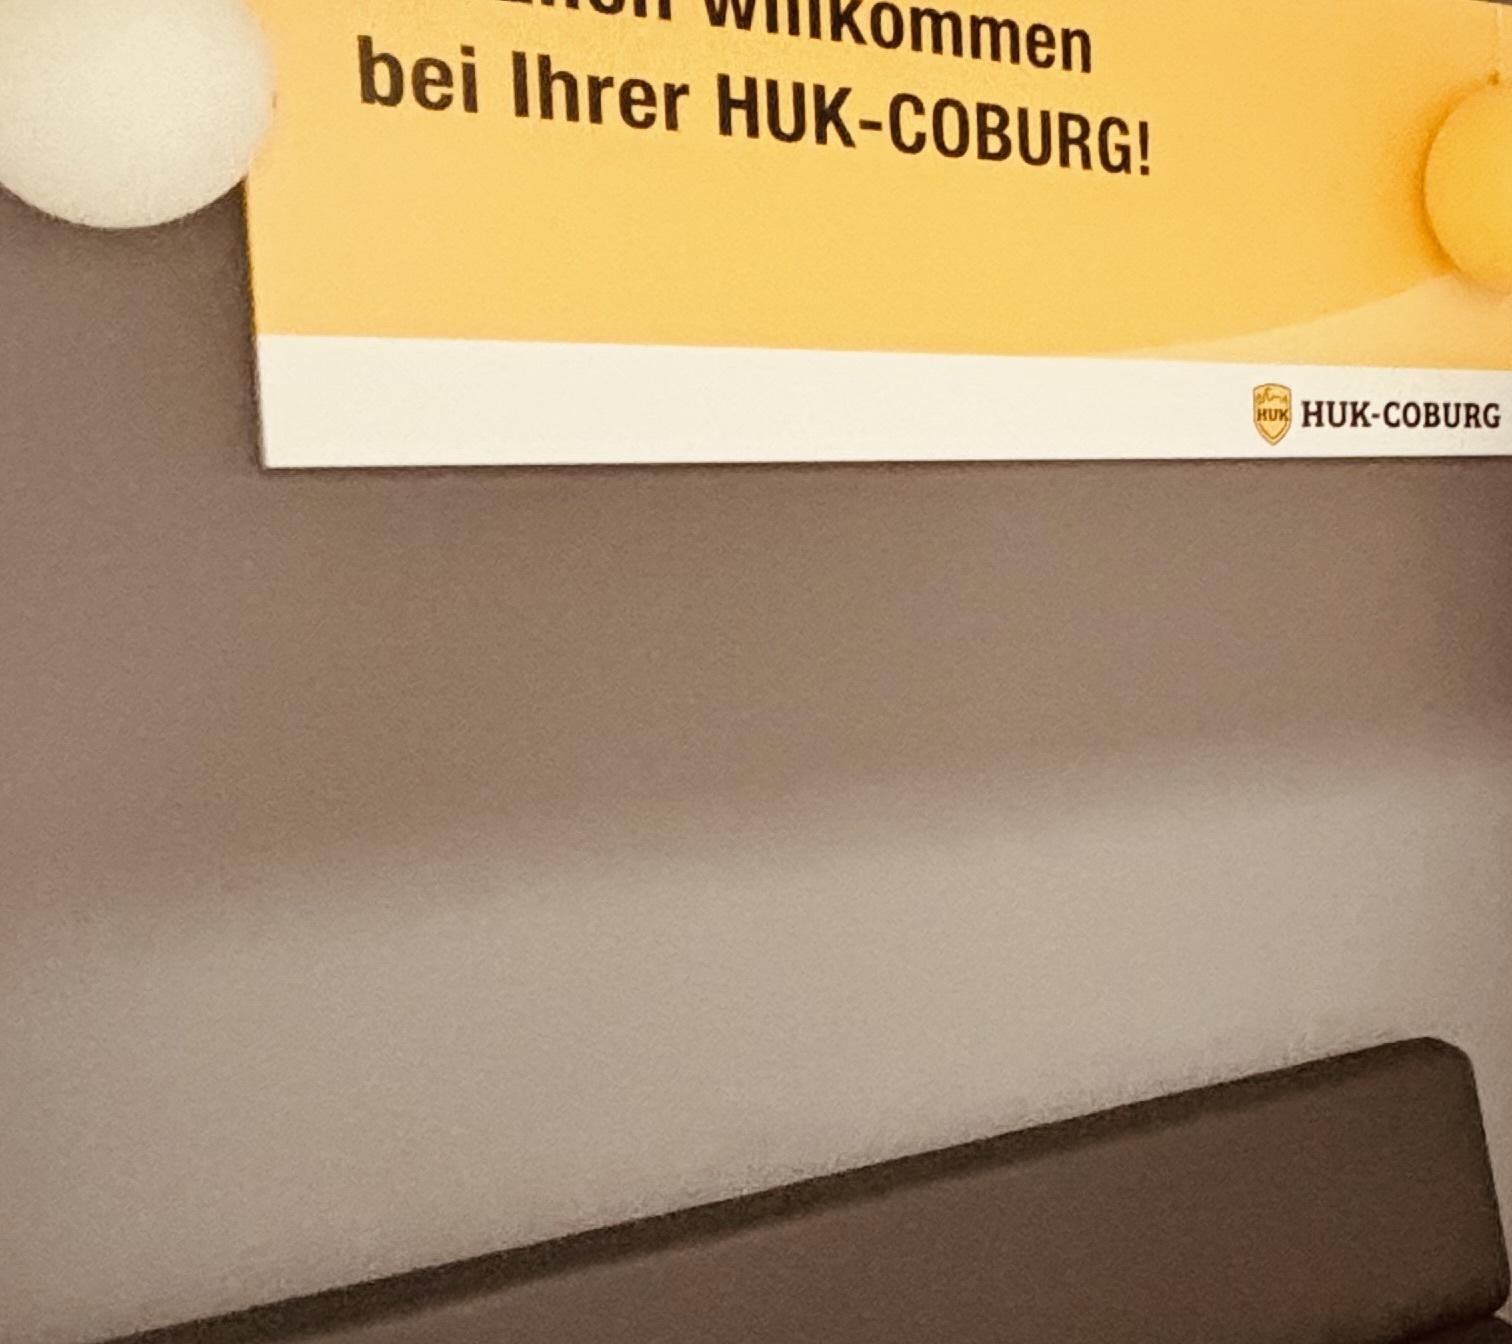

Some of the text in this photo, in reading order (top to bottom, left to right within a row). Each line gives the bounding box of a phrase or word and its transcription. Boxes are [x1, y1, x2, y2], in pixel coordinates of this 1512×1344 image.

[357, 35, 1150, 175] bei Ihrer HUK-COBURG!
[1257, 408, 1289, 422] HUK
[1301, 400, 1501, 429] HUK-COBURG
